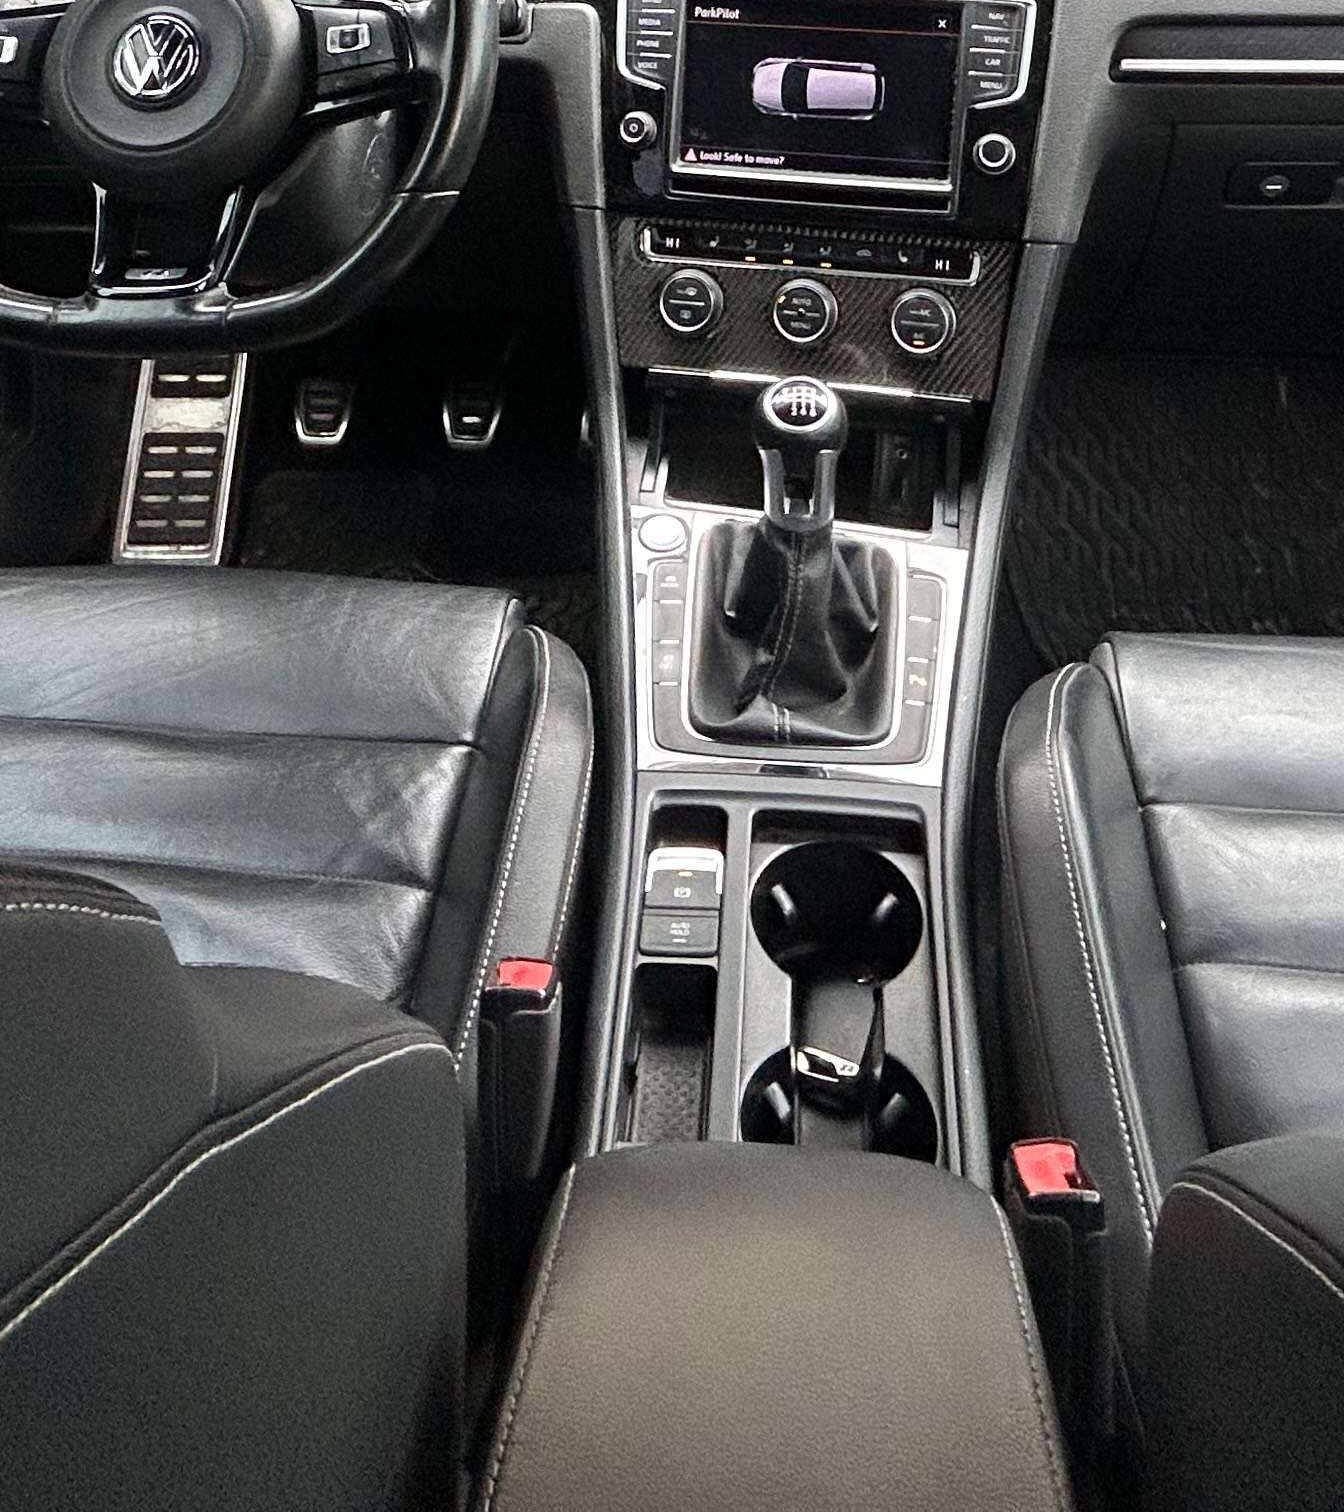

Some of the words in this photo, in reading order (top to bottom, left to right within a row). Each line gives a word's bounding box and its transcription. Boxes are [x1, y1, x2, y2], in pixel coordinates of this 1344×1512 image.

[694, 6, 740, 20] ParkPilot
[984, 58, 1001, 66] CAR
[723, 152, 743, 163] Safe
[744, 154, 755, 163] to
[756, 156, 785, 165] move?
